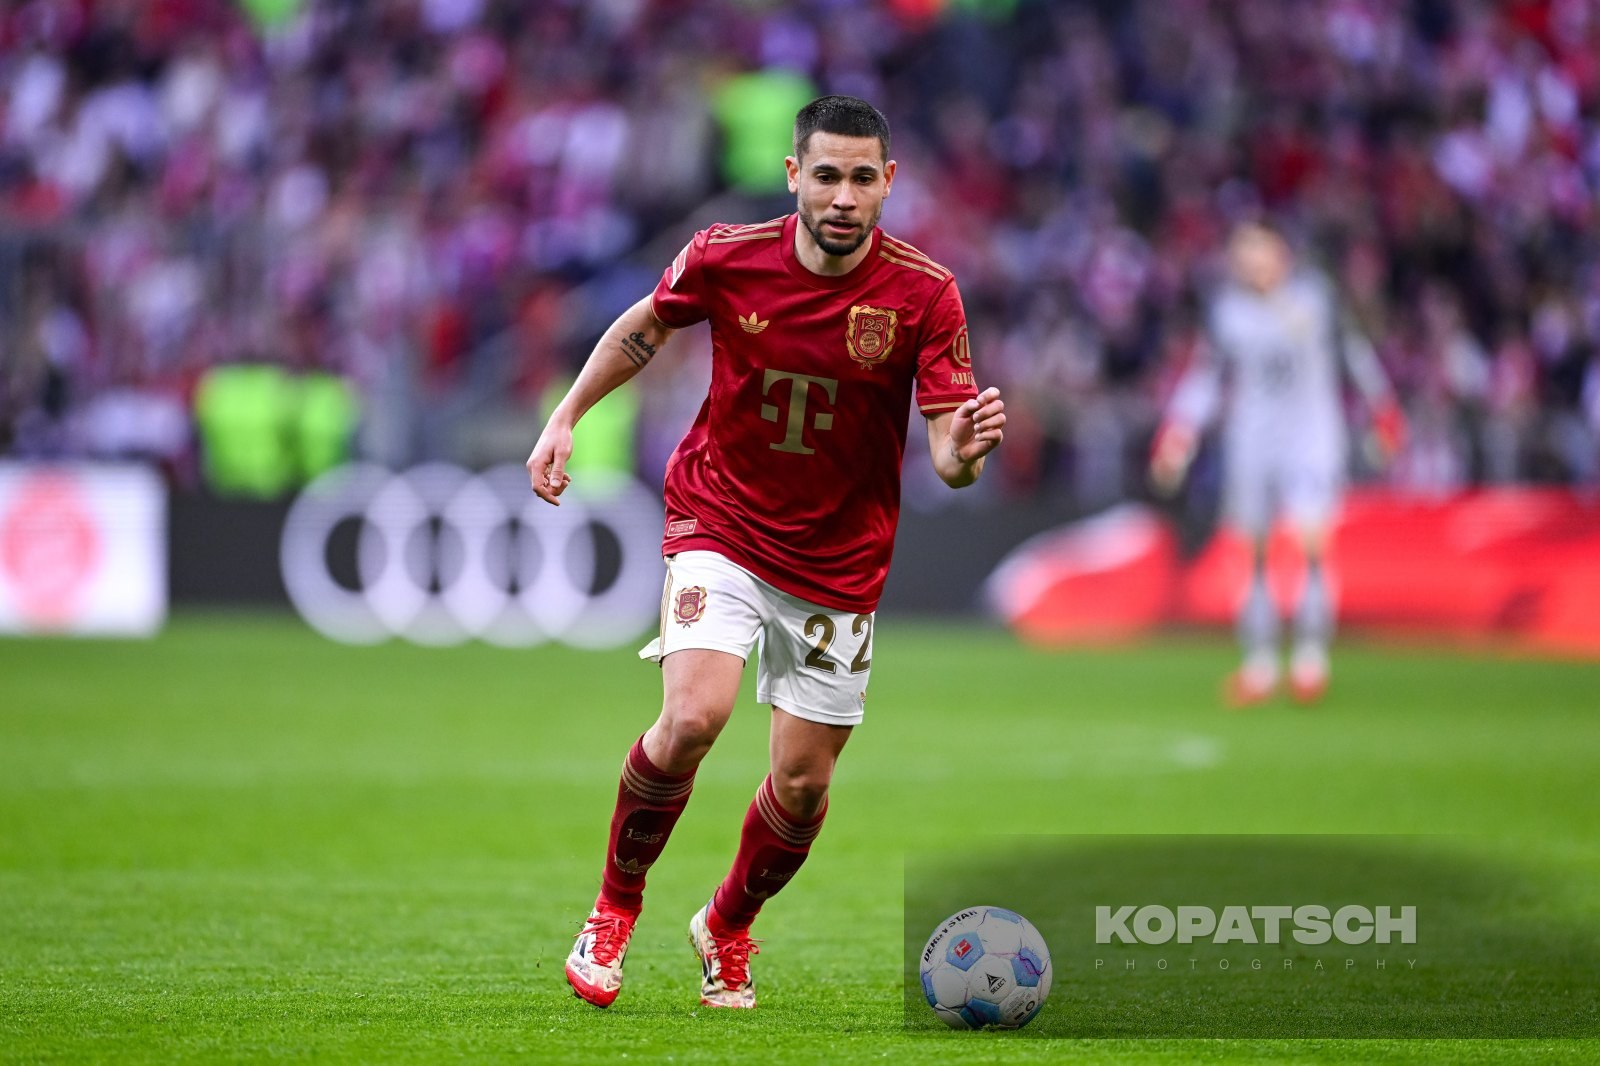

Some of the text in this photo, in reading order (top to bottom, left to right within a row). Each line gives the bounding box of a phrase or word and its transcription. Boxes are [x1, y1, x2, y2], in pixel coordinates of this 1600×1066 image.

[861, 317, 884, 332] 125
[950, 371, 974, 385] Alli
[803, 613, 872, 675] 22
[989, 977, 1007, 995] SELECT
